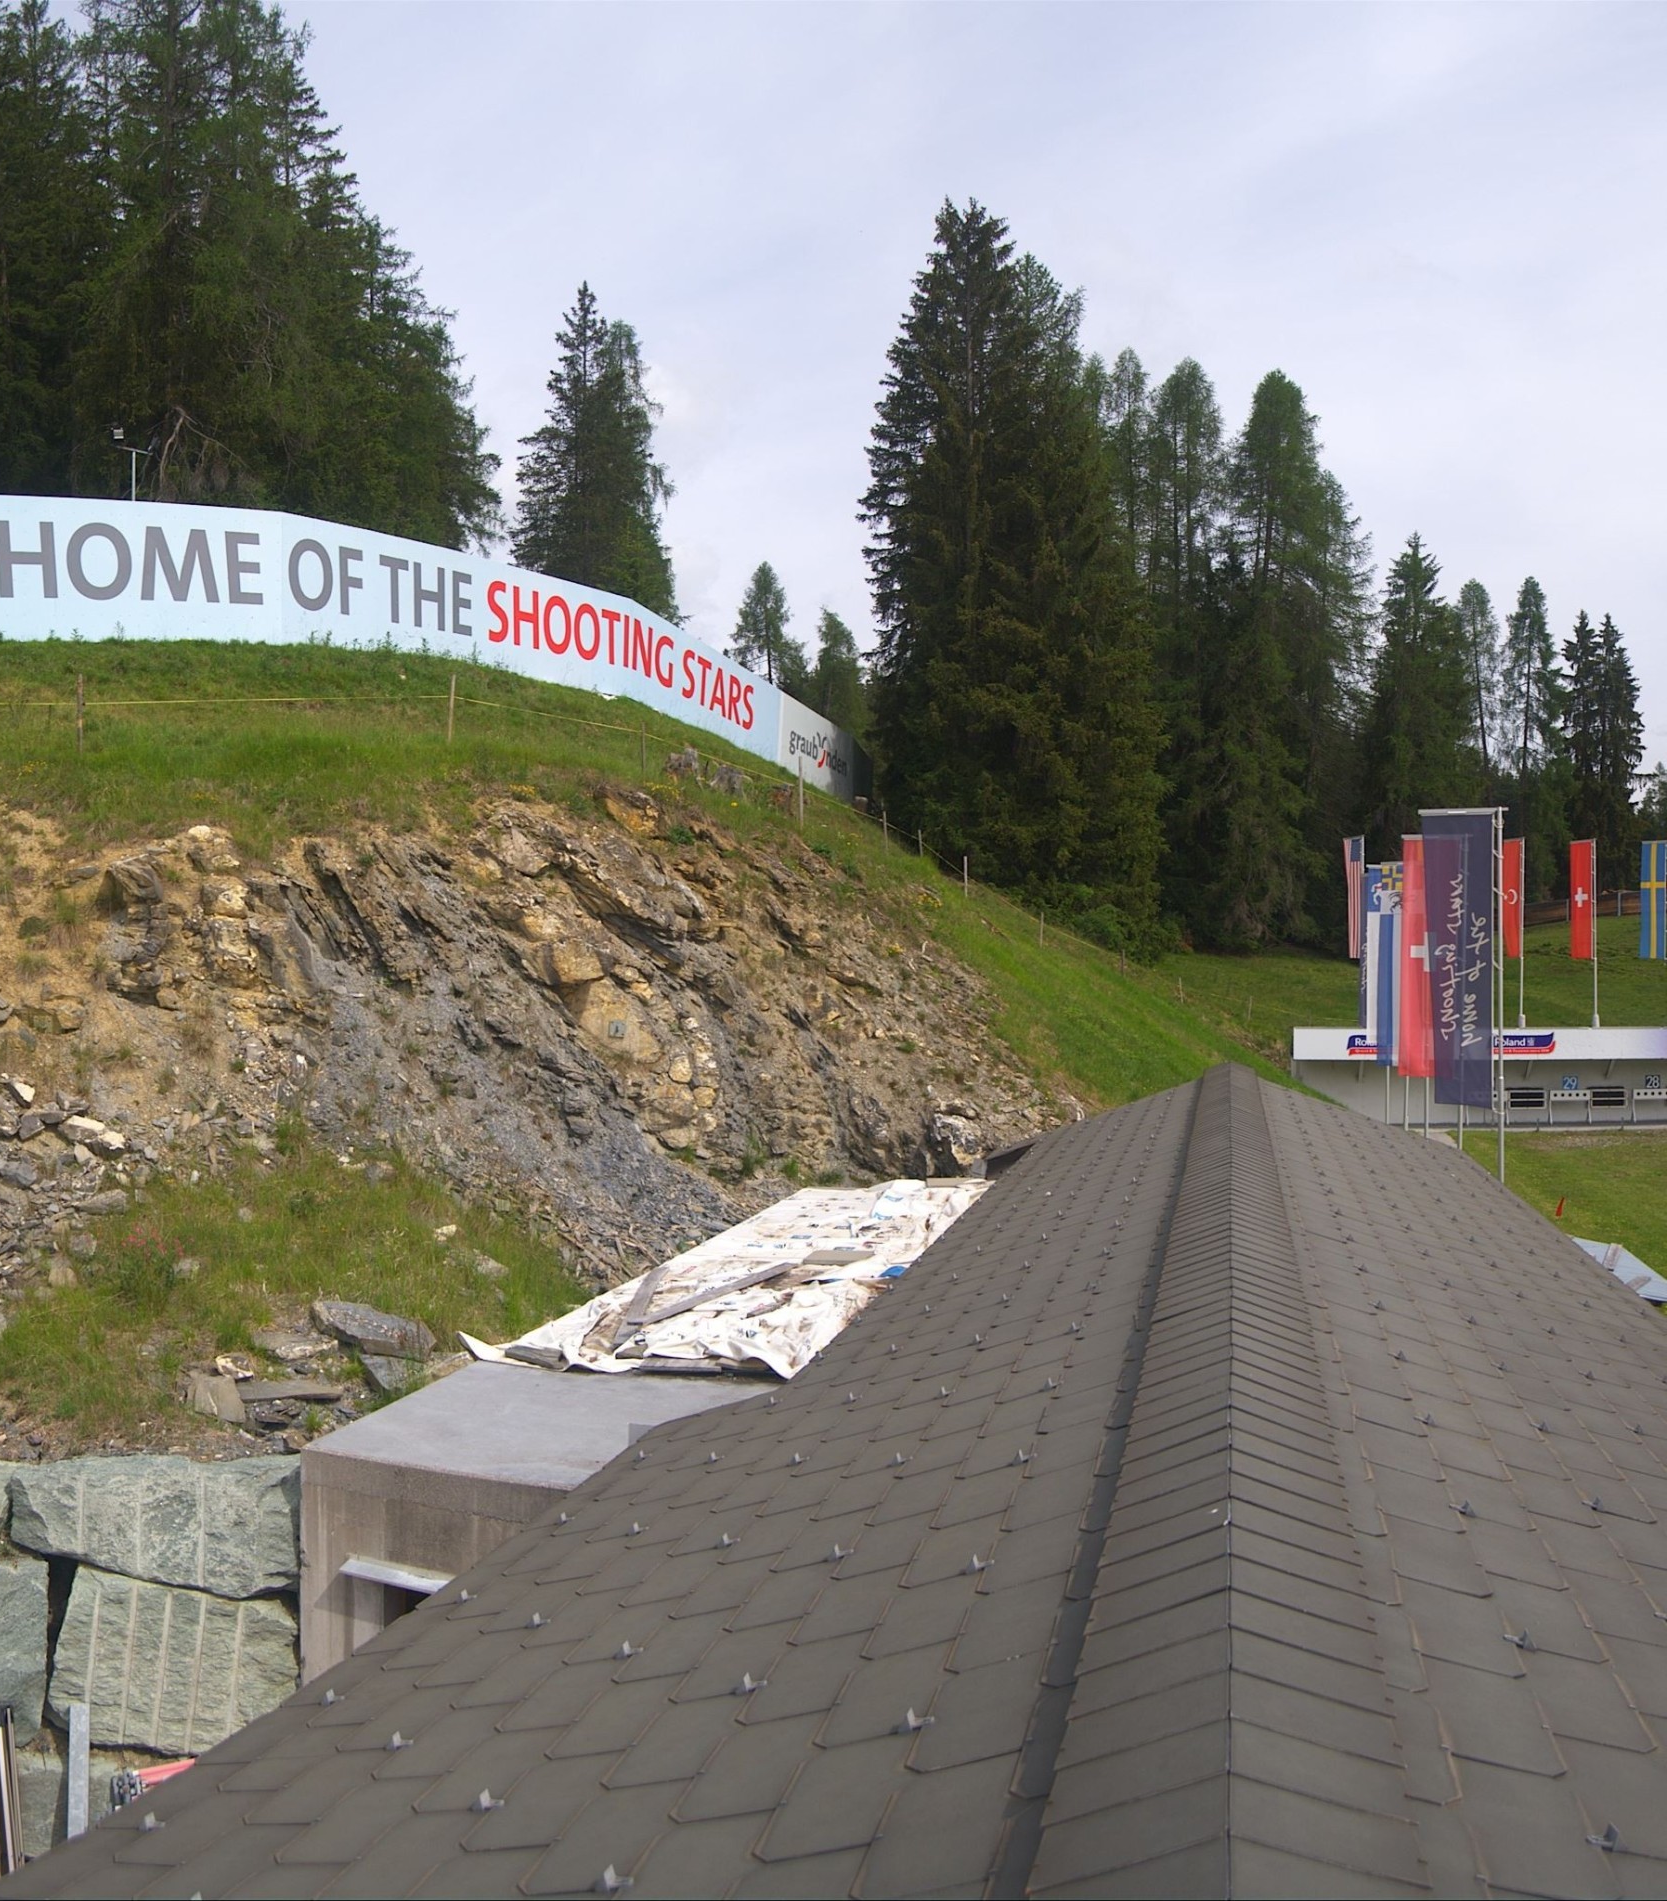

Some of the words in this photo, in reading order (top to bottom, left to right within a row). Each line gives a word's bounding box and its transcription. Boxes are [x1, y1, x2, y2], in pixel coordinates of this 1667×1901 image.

[288, 538, 364, 615] OF
[378, 554, 473, 636] THE
[487, 580, 674, 688] SHOOTING
[682, 649, 755, 730] STARS
[1563, 1077, 1577, 1090] 29
[1646, 1075, 1660, 1088] 28
